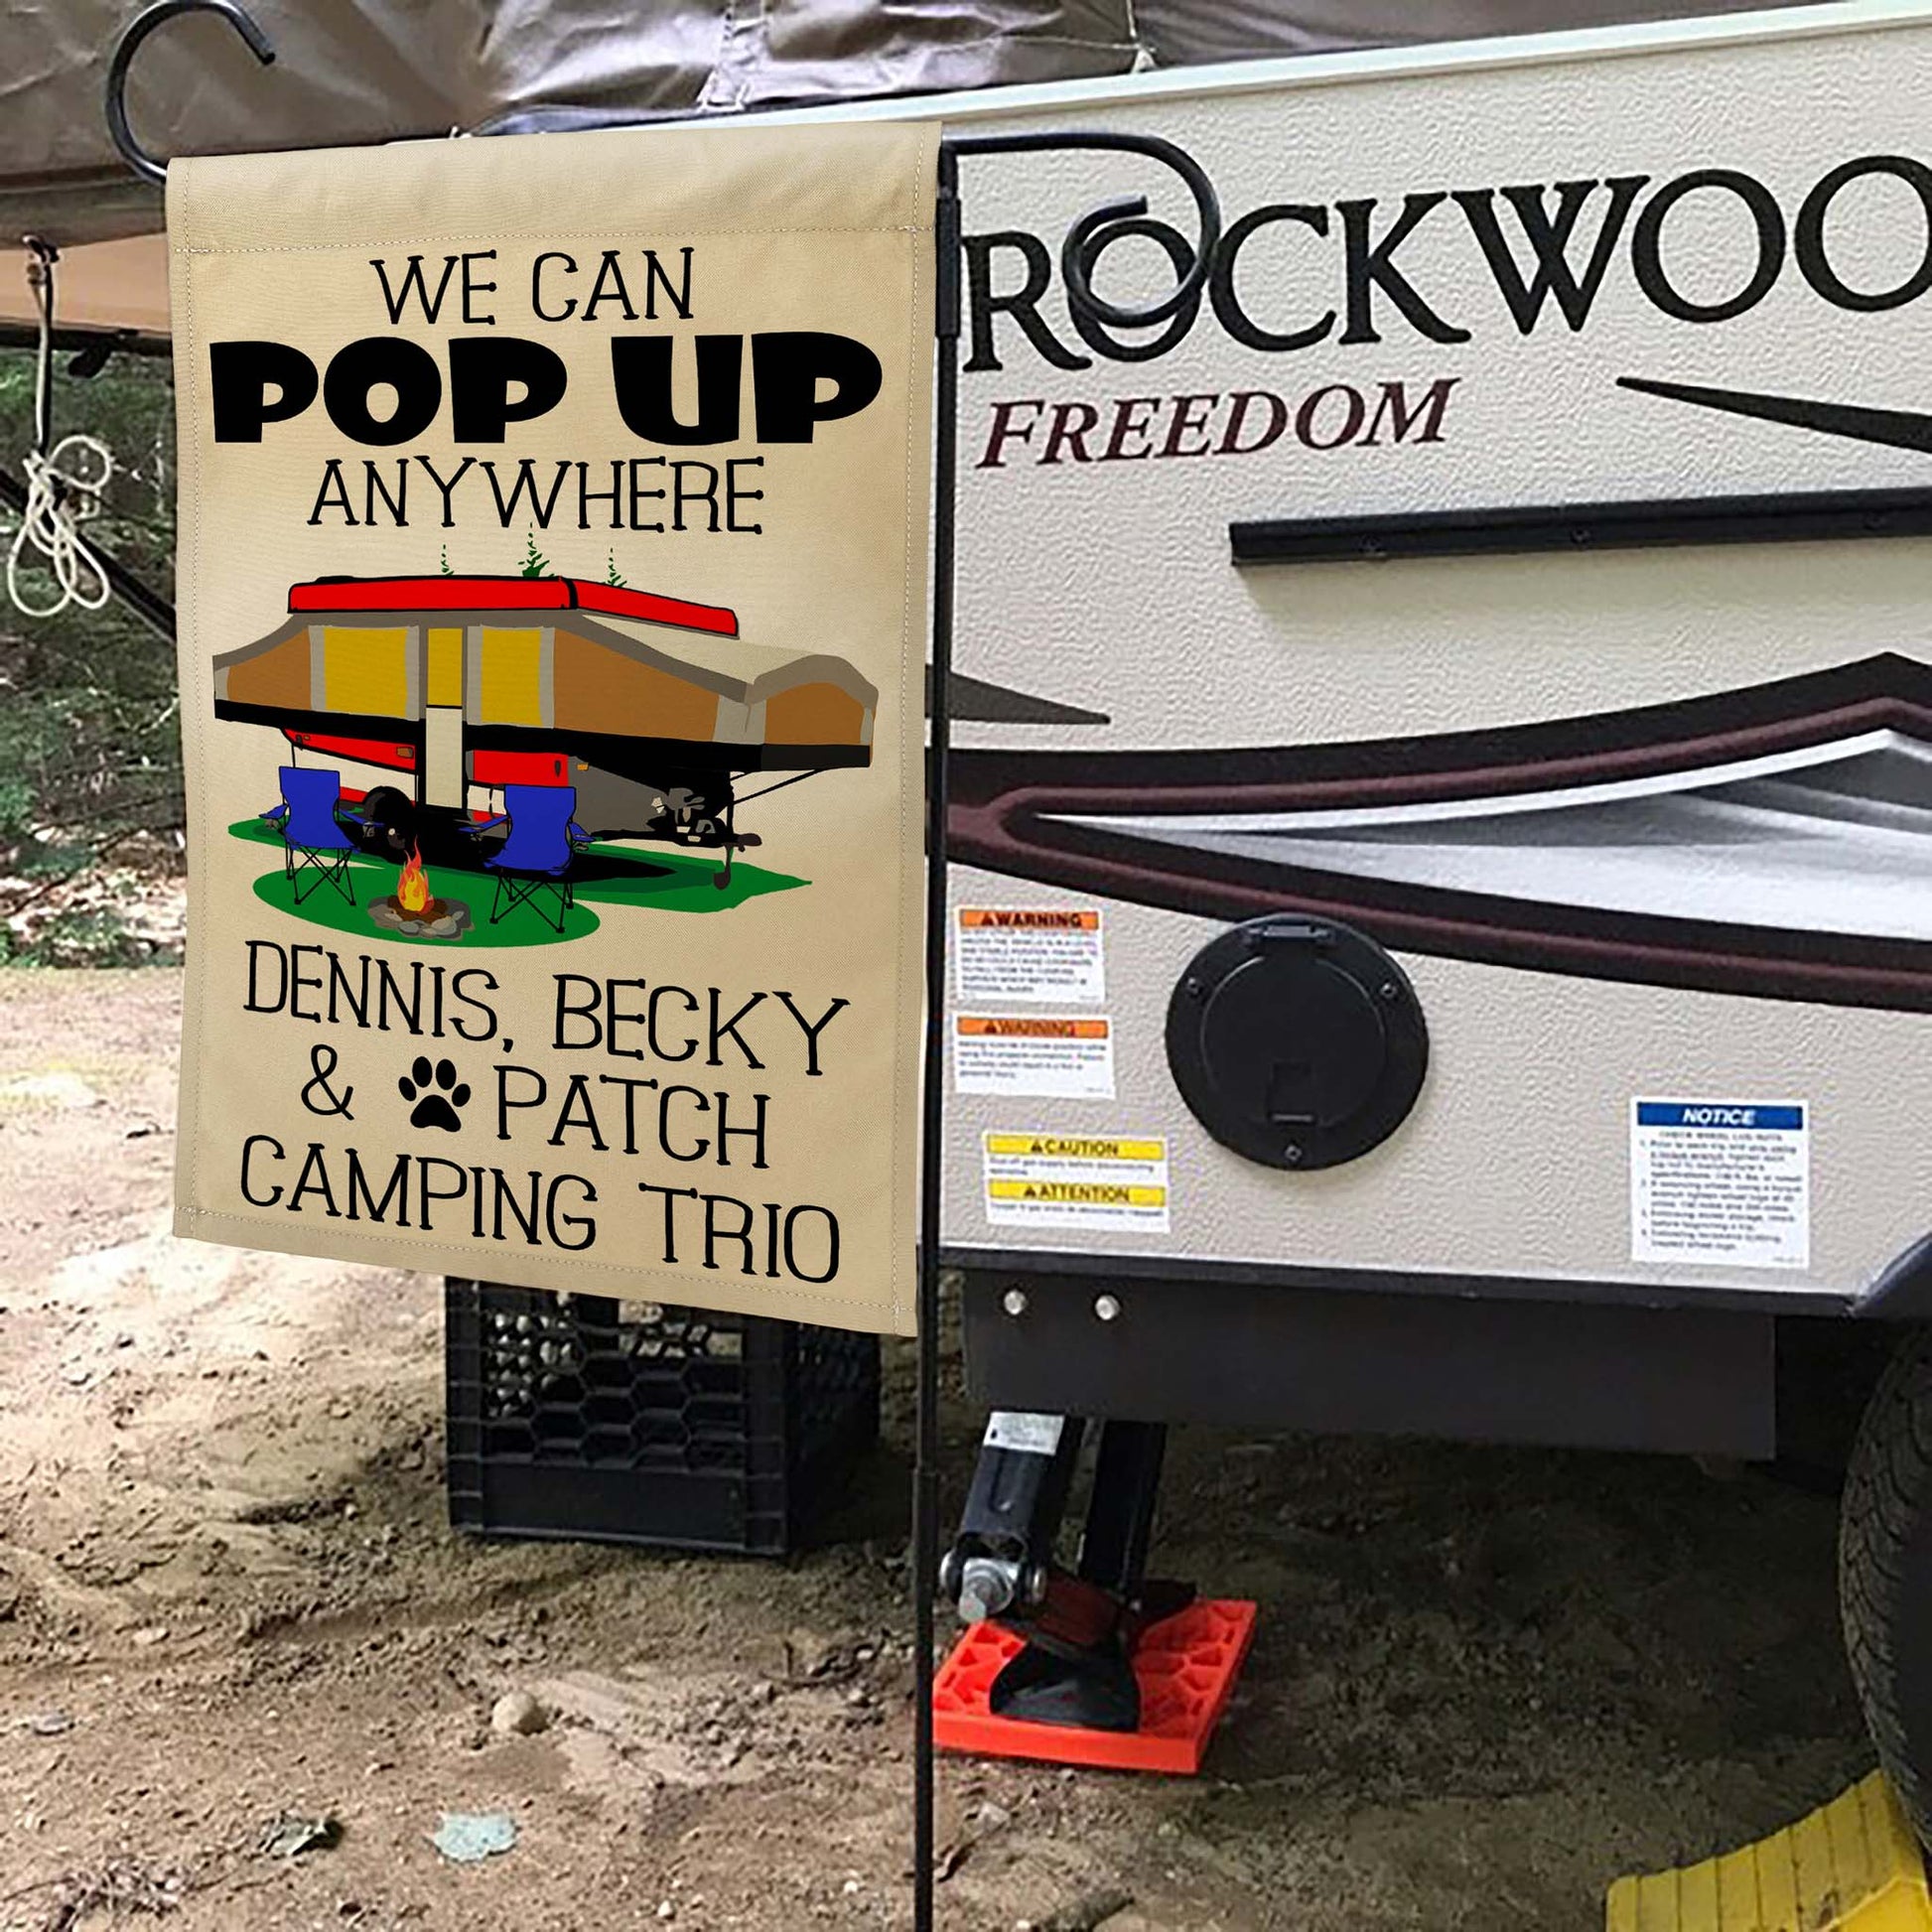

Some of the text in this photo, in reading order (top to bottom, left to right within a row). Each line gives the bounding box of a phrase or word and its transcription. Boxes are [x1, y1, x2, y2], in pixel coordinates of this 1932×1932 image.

[369, 246, 695, 326] WE CAN
[962, 156, 1932, 373] ROCKWOO
[208, 331, 883, 447] POP UP
[975, 377, 1461, 470] FREEDOM
[307, 455, 764, 535] ANYWHERE
[994, 912, 1082, 928] WARNING
[243, 939, 851, 1076] DENNIS, BECKY
[300, 1043, 771, 1170] & PATCH
[1043, 1140, 1119, 1157] CAUTION
[1682, 1107, 1756, 1126] NOTICE
[240, 1134, 840, 1284] CAMPING TRIO
[1038, 1182, 1131, 1202] ATTENTION
